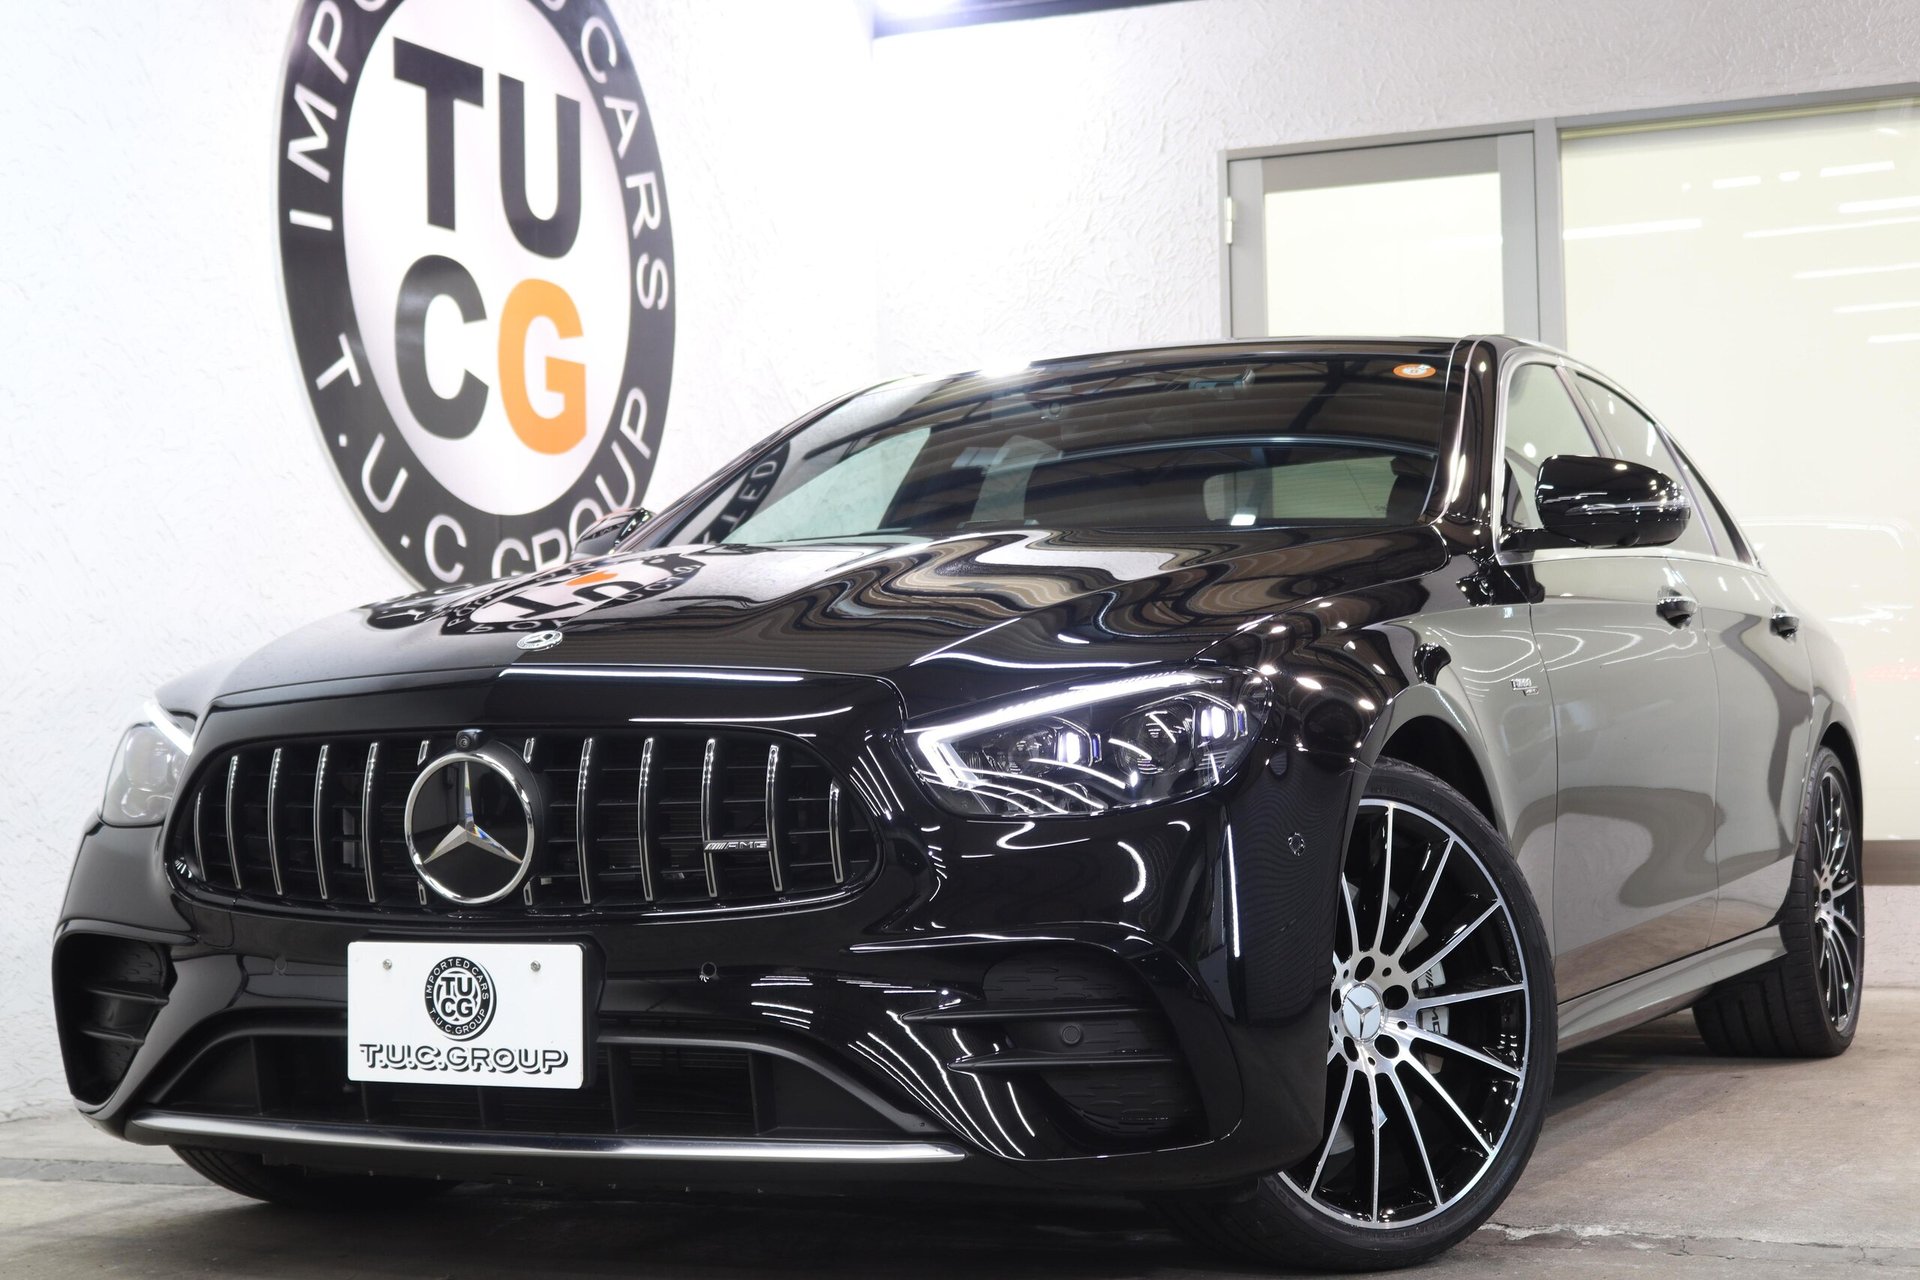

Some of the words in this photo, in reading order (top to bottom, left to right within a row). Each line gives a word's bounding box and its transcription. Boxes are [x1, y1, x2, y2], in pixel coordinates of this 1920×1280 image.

[393, 37, 582, 259] TU
[580, 16, 669, 310] CARS
[395, 255, 587, 455] CG
[426, 958, 470, 998] IMPORTED
[472, 966, 489, 1000] CARS
[440, 976, 473, 996] TU
[440, 997, 473, 1018] CG
[359, 1043, 569, 1075] T.U.C.GROUP
